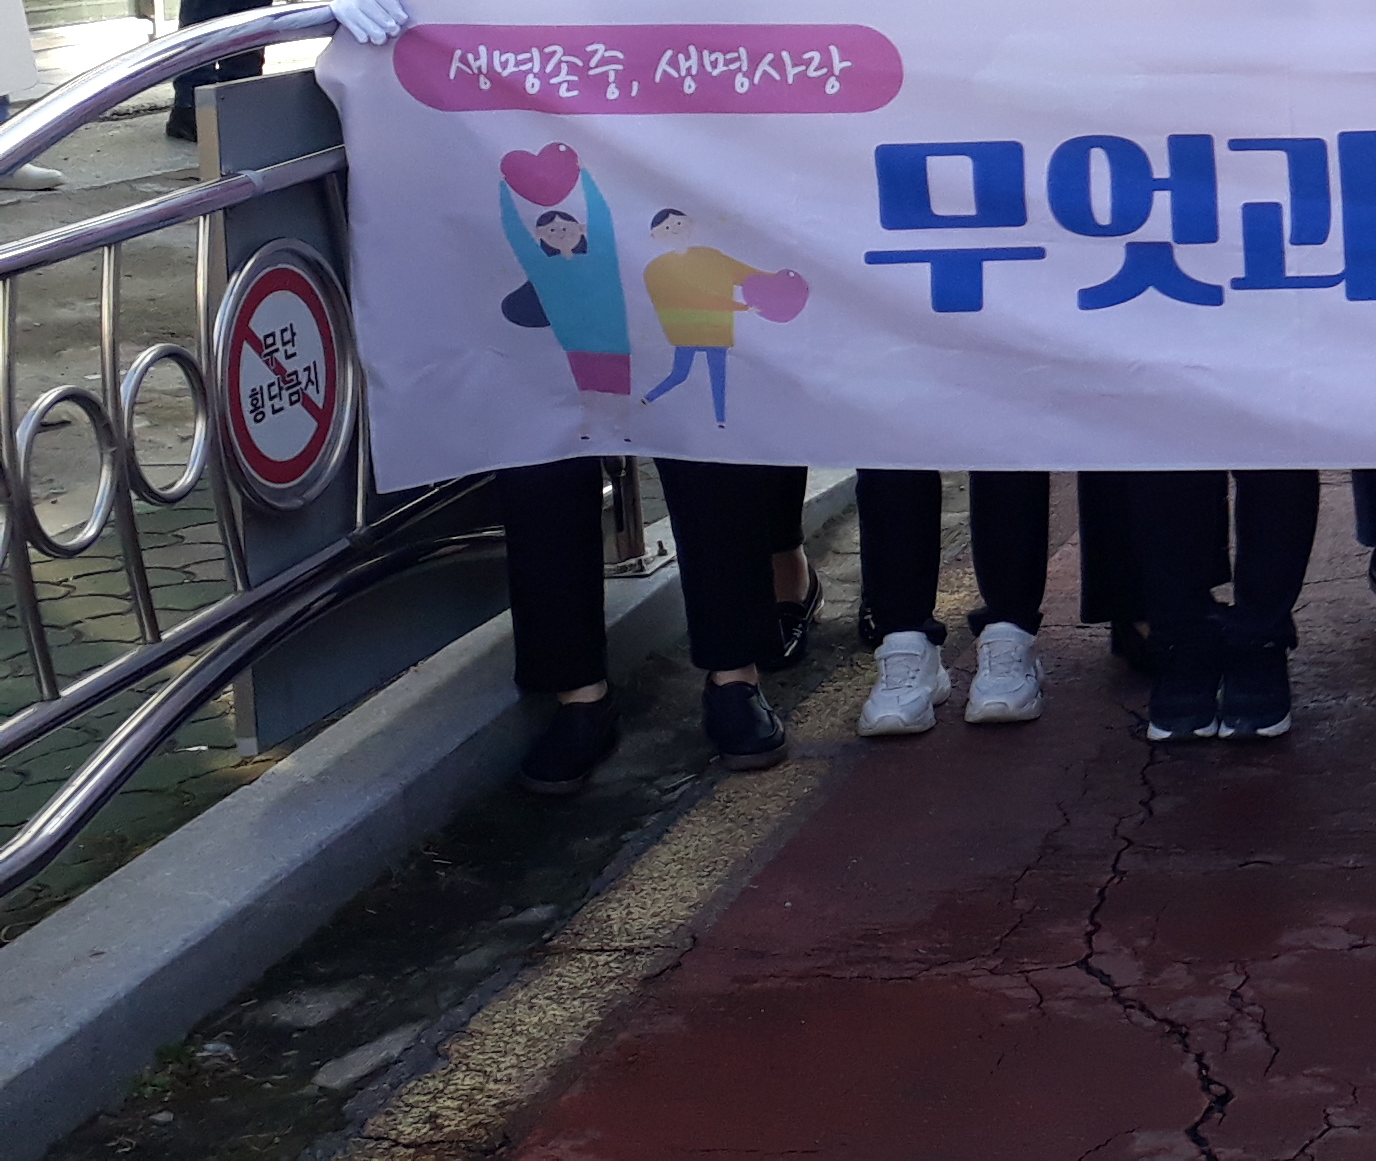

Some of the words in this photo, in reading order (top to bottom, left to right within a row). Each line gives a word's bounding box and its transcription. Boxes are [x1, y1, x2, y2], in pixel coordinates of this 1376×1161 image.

[448, 43, 639, 100] 생명존중,
[654, 44, 852, 95] 생명사랑
[262, 322, 297, 360] 무단
[248, 360, 320, 424] 횡단금지
